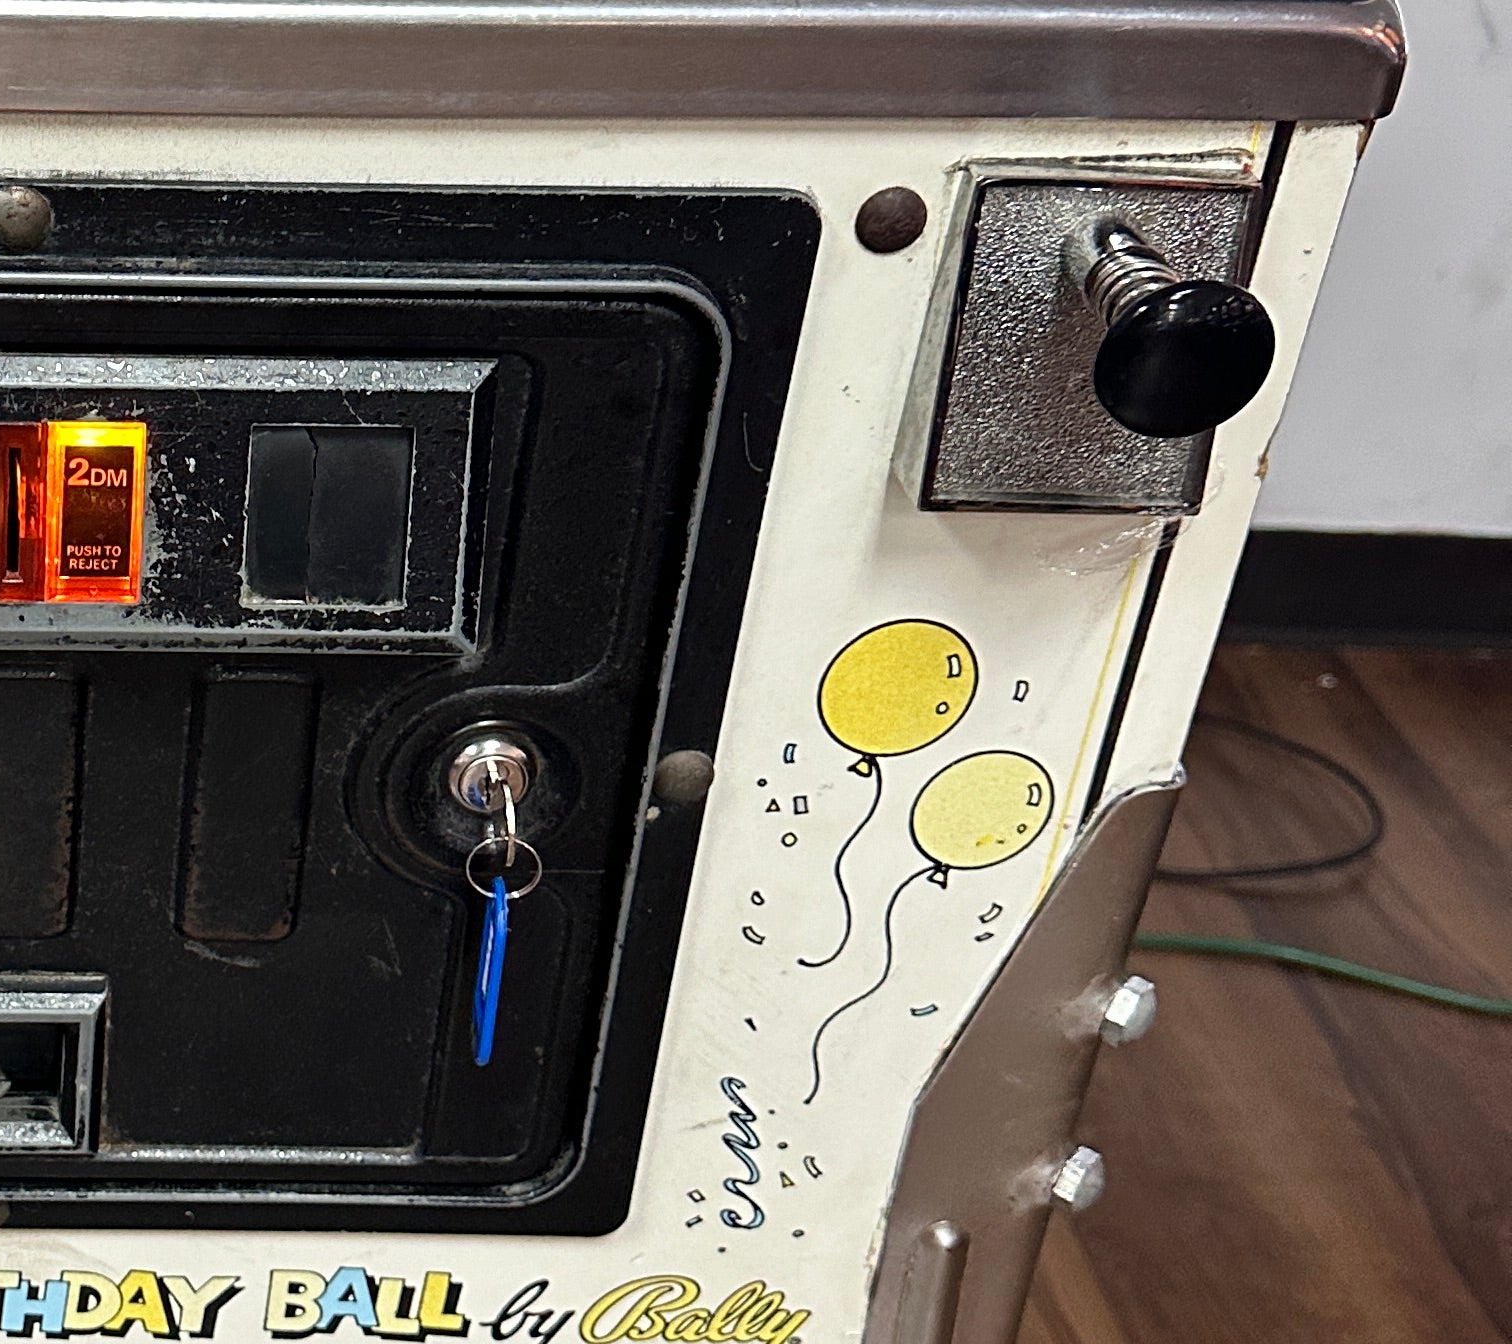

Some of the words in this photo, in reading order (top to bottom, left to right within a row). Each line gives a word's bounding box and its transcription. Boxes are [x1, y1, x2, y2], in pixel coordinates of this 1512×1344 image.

[67, 457, 128, 488] 2DM
[66, 544, 103, 558] PUSH
[103, 545, 122, 558] TO
[68, 558, 120, 571] REJECT
[264, 1266, 472, 1343] BALL
